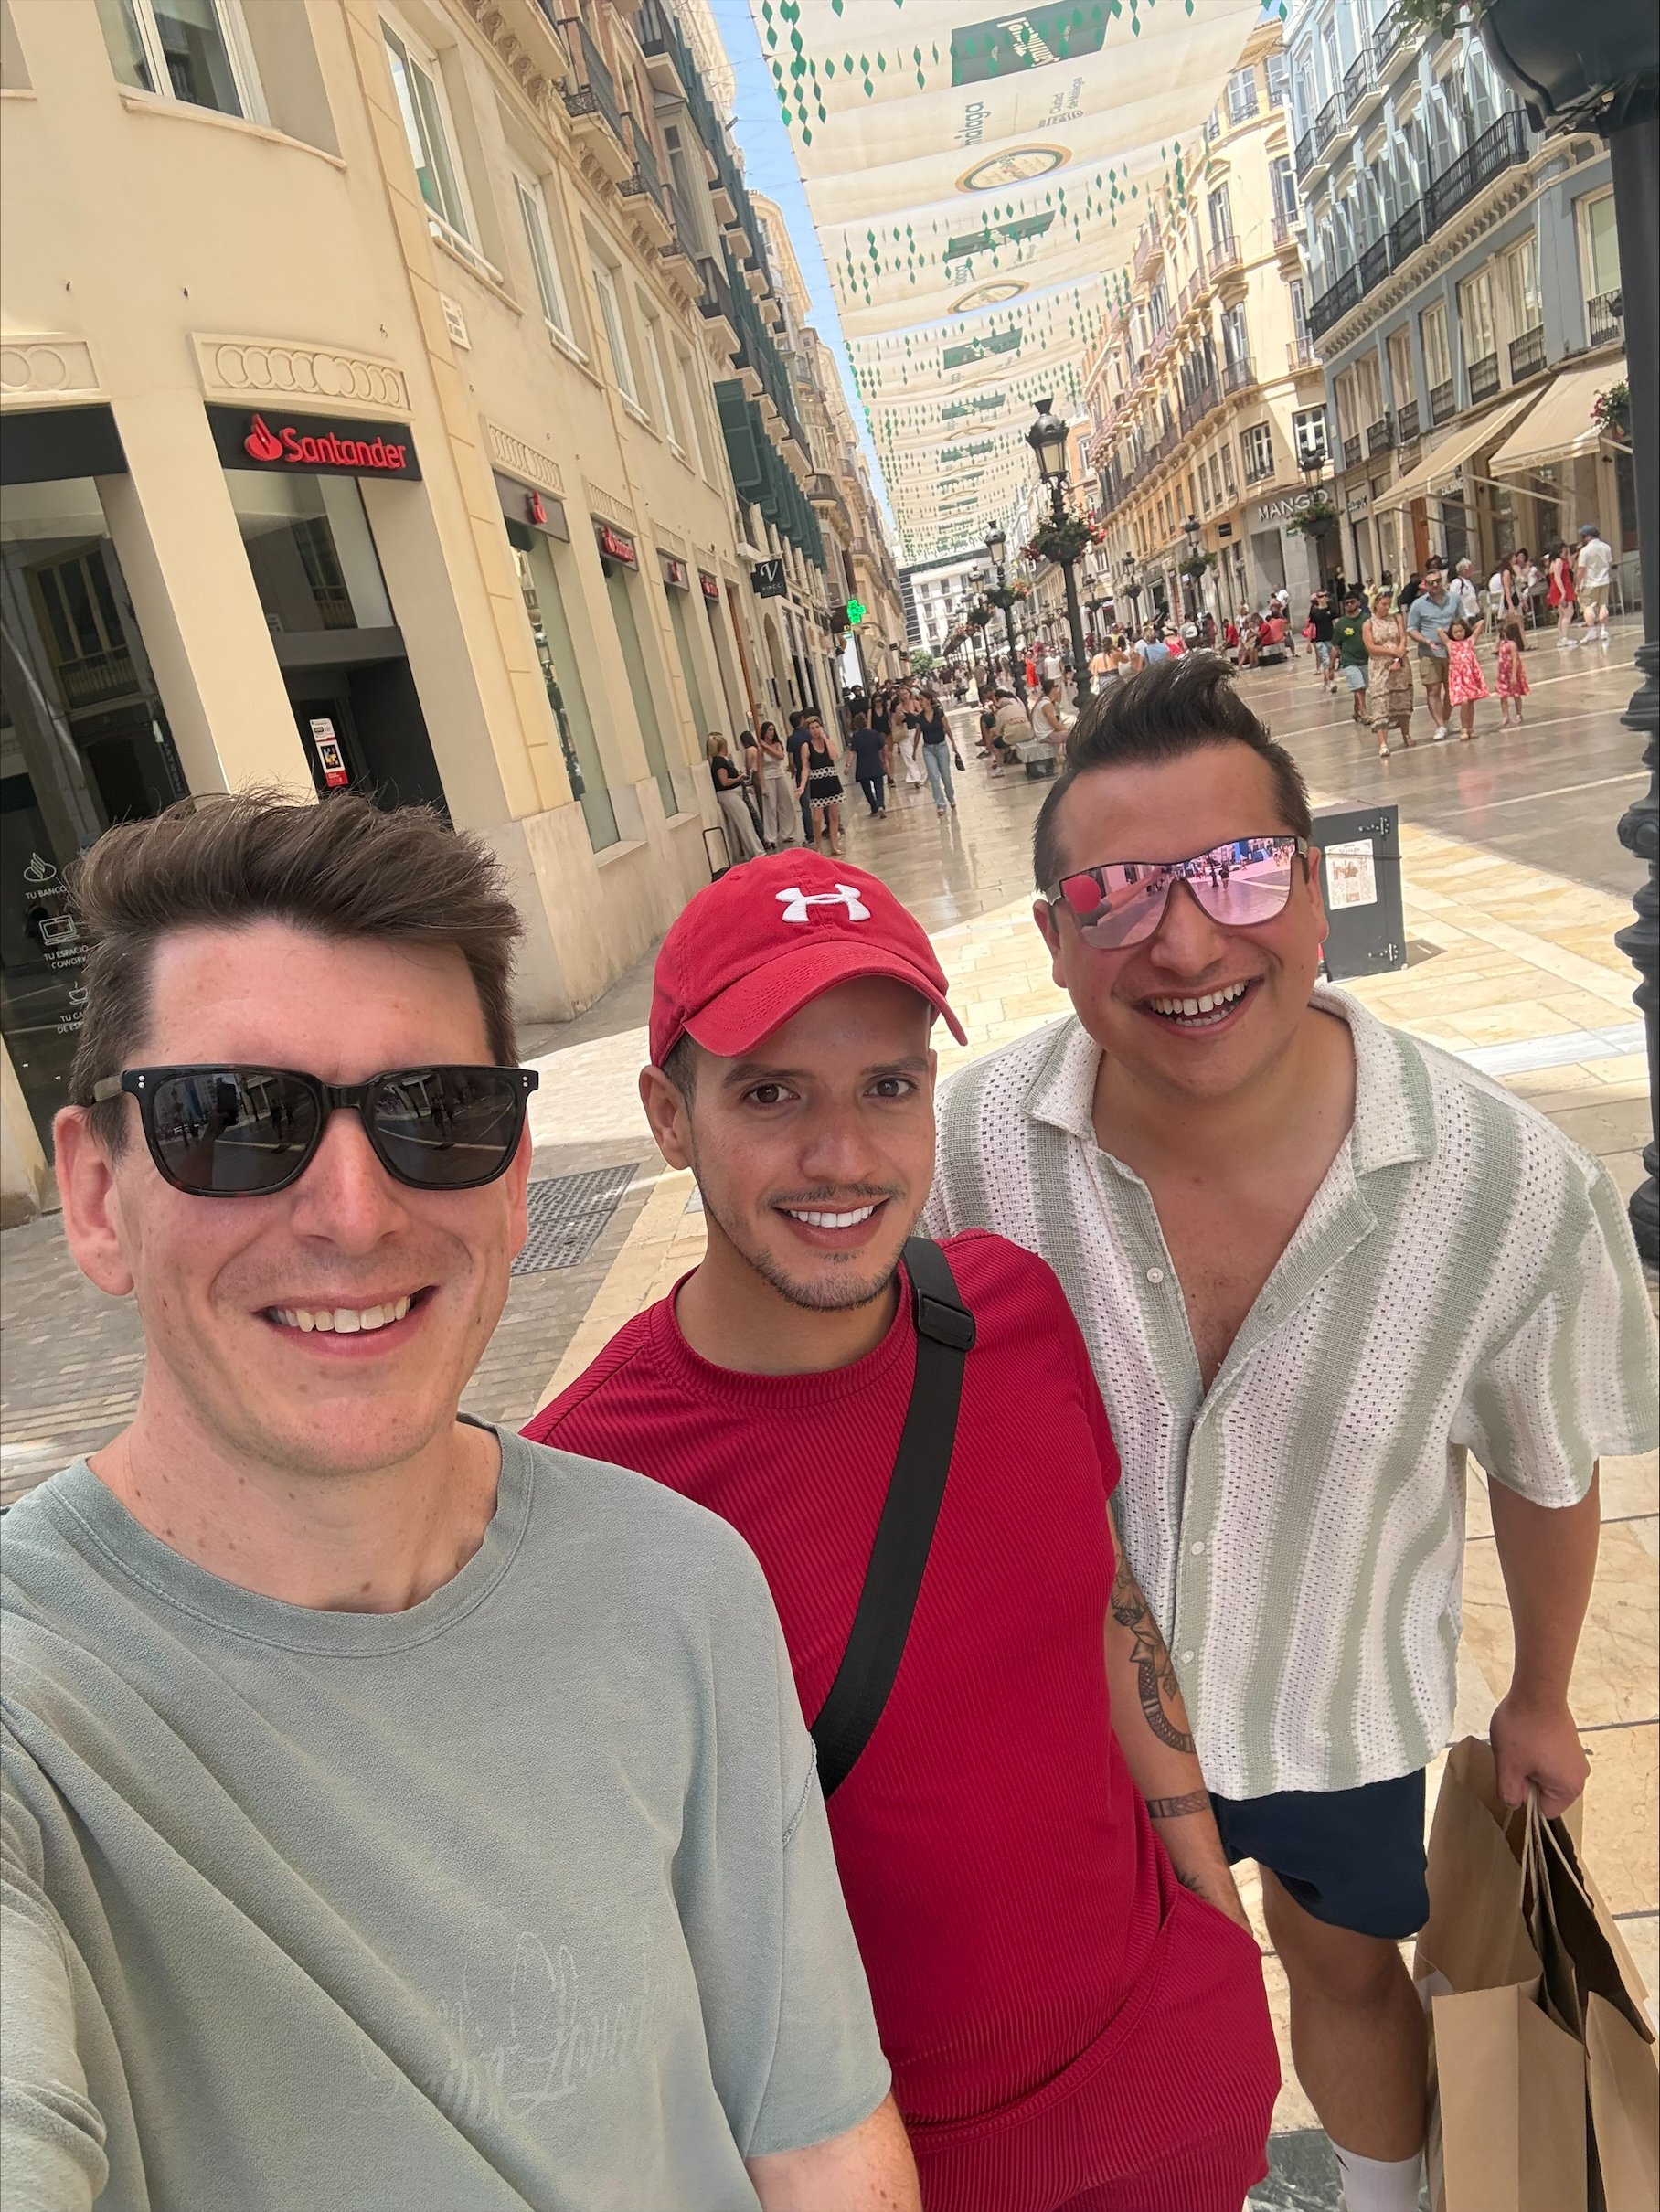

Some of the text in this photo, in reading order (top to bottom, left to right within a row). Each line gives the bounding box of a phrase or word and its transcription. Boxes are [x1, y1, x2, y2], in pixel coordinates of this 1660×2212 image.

[281, 427, 406, 469] Santander
[25, 885, 68, 900] TU BANCO
[43, 944, 90, 961] TU ESPACIO
[60, 1014, 72, 1023] TU
[57, 1025, 69, 1035] DE
